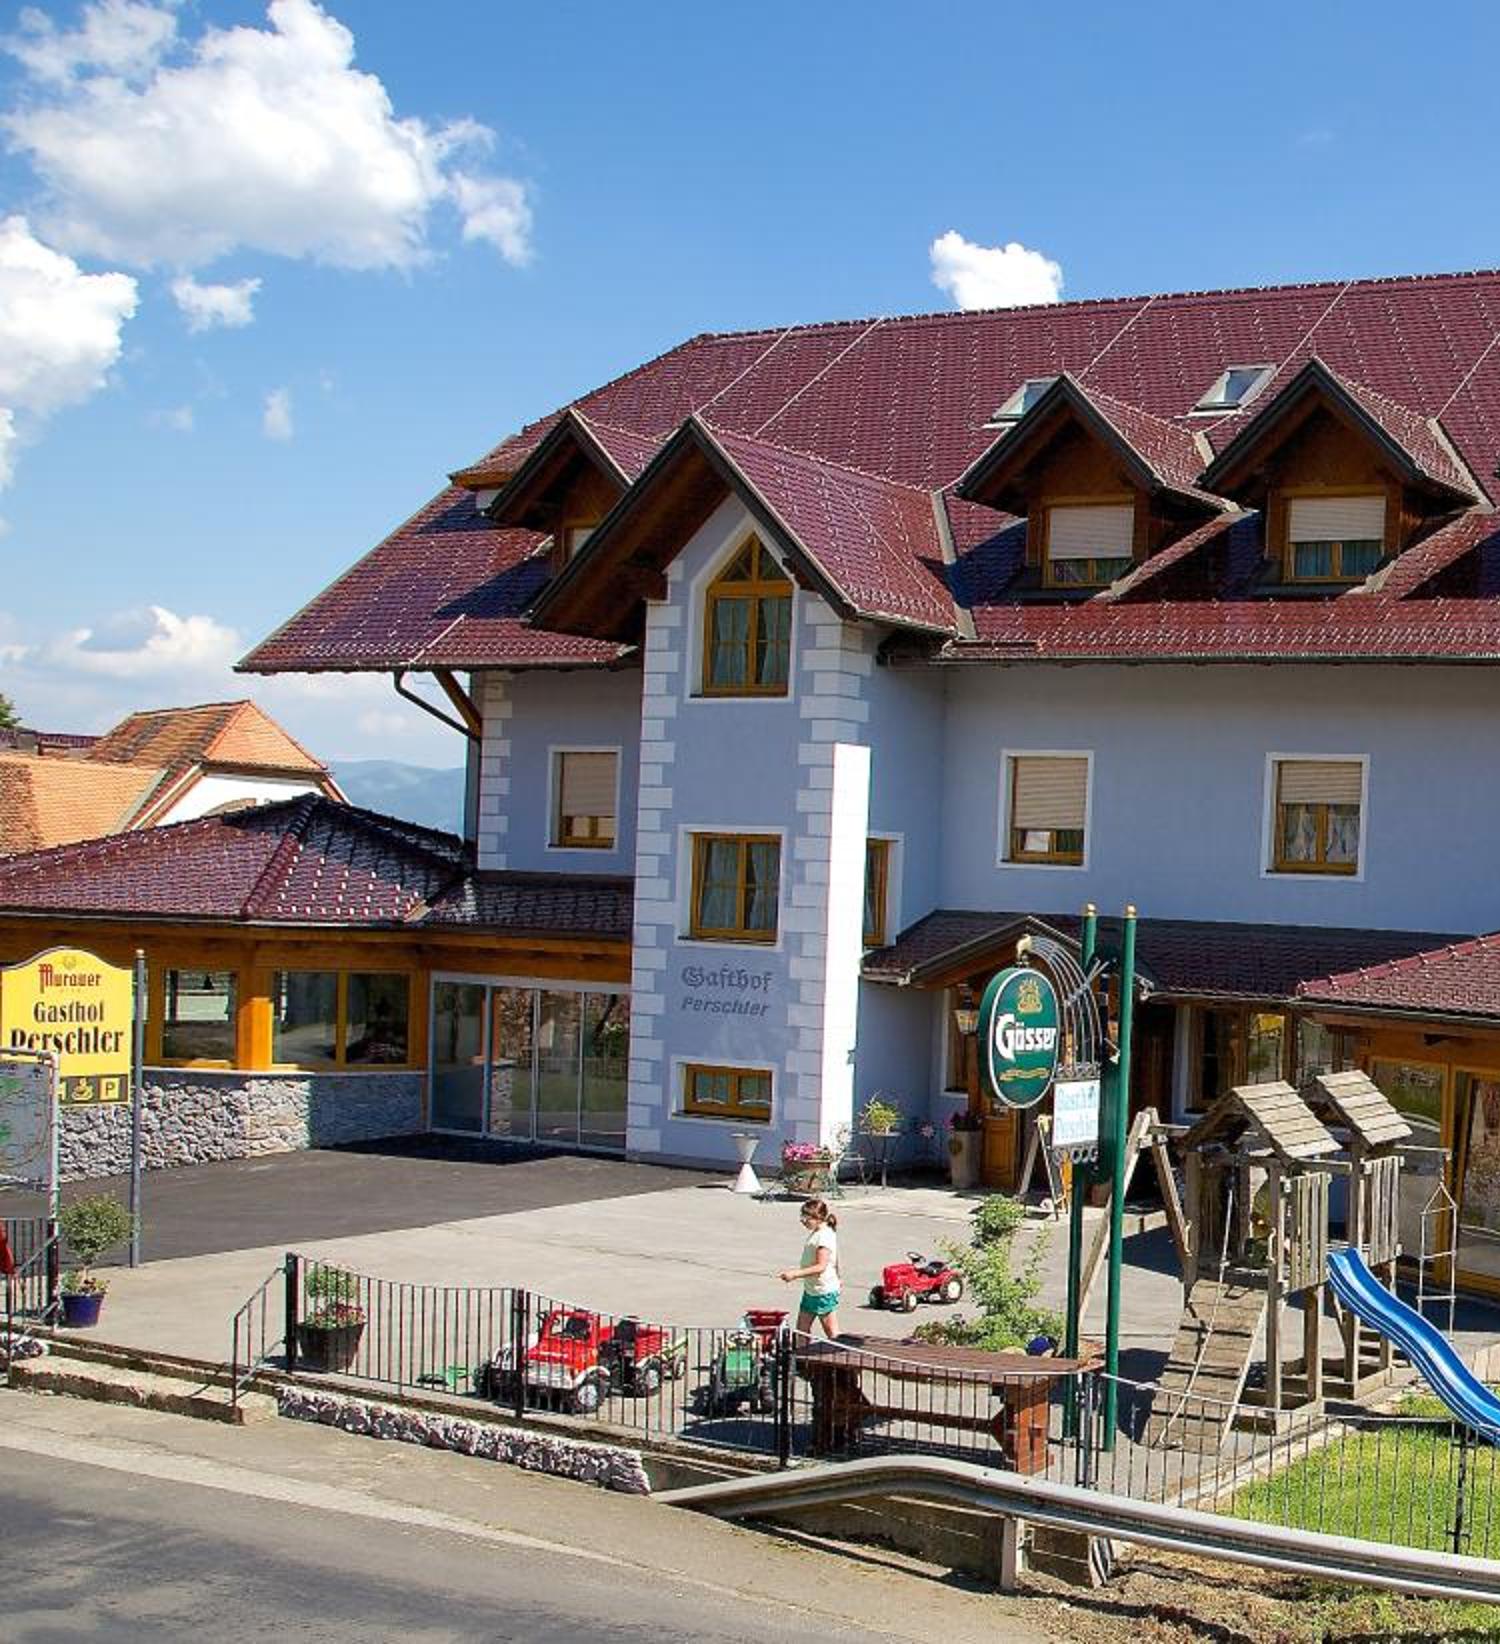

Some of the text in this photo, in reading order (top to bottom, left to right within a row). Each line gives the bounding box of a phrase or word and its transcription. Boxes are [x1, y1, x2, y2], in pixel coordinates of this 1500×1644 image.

[38, 963, 102, 994] Murauer
[682, 963, 773, 993] Gasthof
[33, 1001, 104, 1023] Gasthof
[682, 997, 770, 1016] Perschler
[10, 1026, 124, 1055] Perschler
[996, 1013, 1056, 1062] Gösser
[105, 1082, 115, 1096] P
